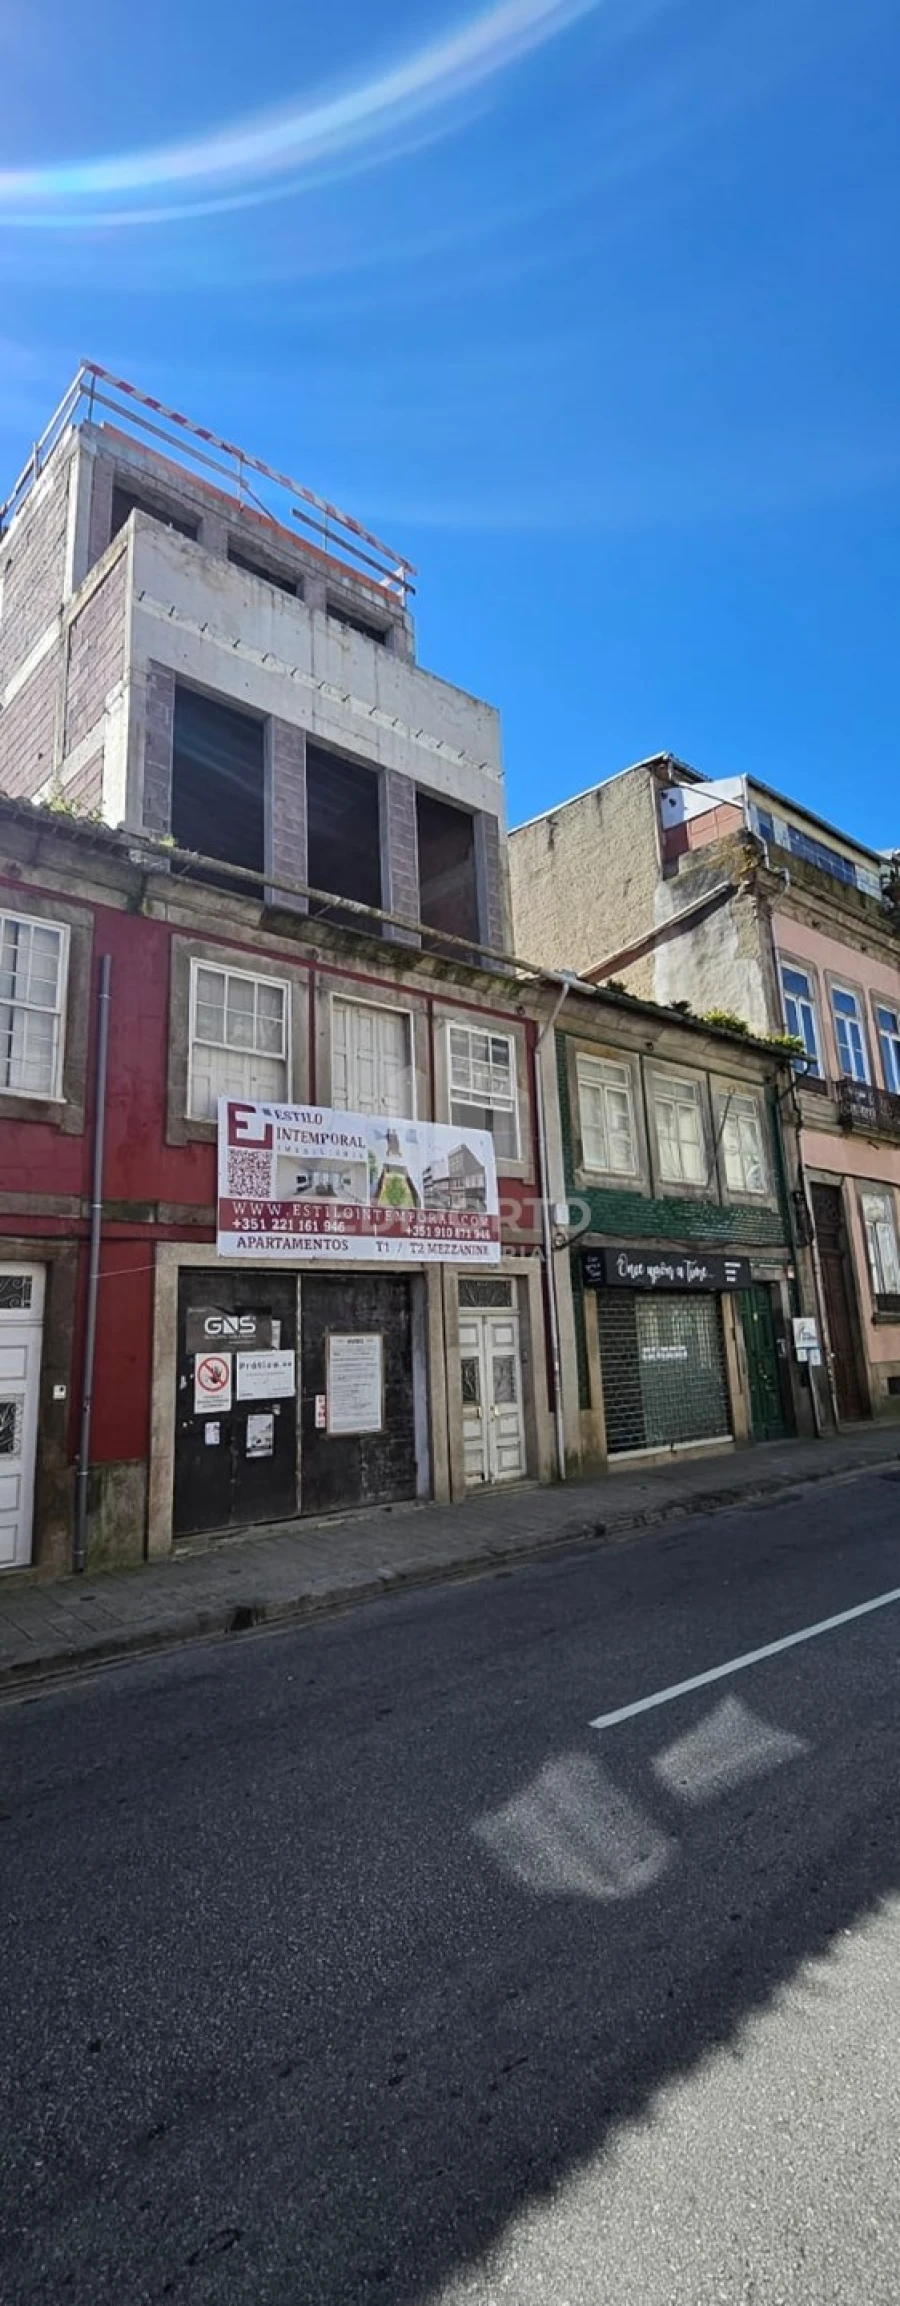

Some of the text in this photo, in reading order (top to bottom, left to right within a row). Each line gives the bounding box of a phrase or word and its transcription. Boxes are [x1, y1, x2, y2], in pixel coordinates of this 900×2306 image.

[274, 1108, 323, 1125] ESTILO
[276, 1127, 366, 1149] INTEMPORAL
[232, 1201, 490, 1227] WWW.ESTILOINTEMPORAL.COM
[232, 1218, 266, 1231] +351
[271, 1218, 293, 1231] 221
[299, 1219, 318, 1232] 161
[323, 1220, 345, 1233] 946
[406, 1225, 432, 1237] +351
[435, 1226, 451, 1238] 910
[237, 1236, 349, 1251] APARTAMENTOS
[375, 1240, 390, 1253] T1
[410, 1241, 425, 1254] T2
[616, 1252, 643, 1278] Once
